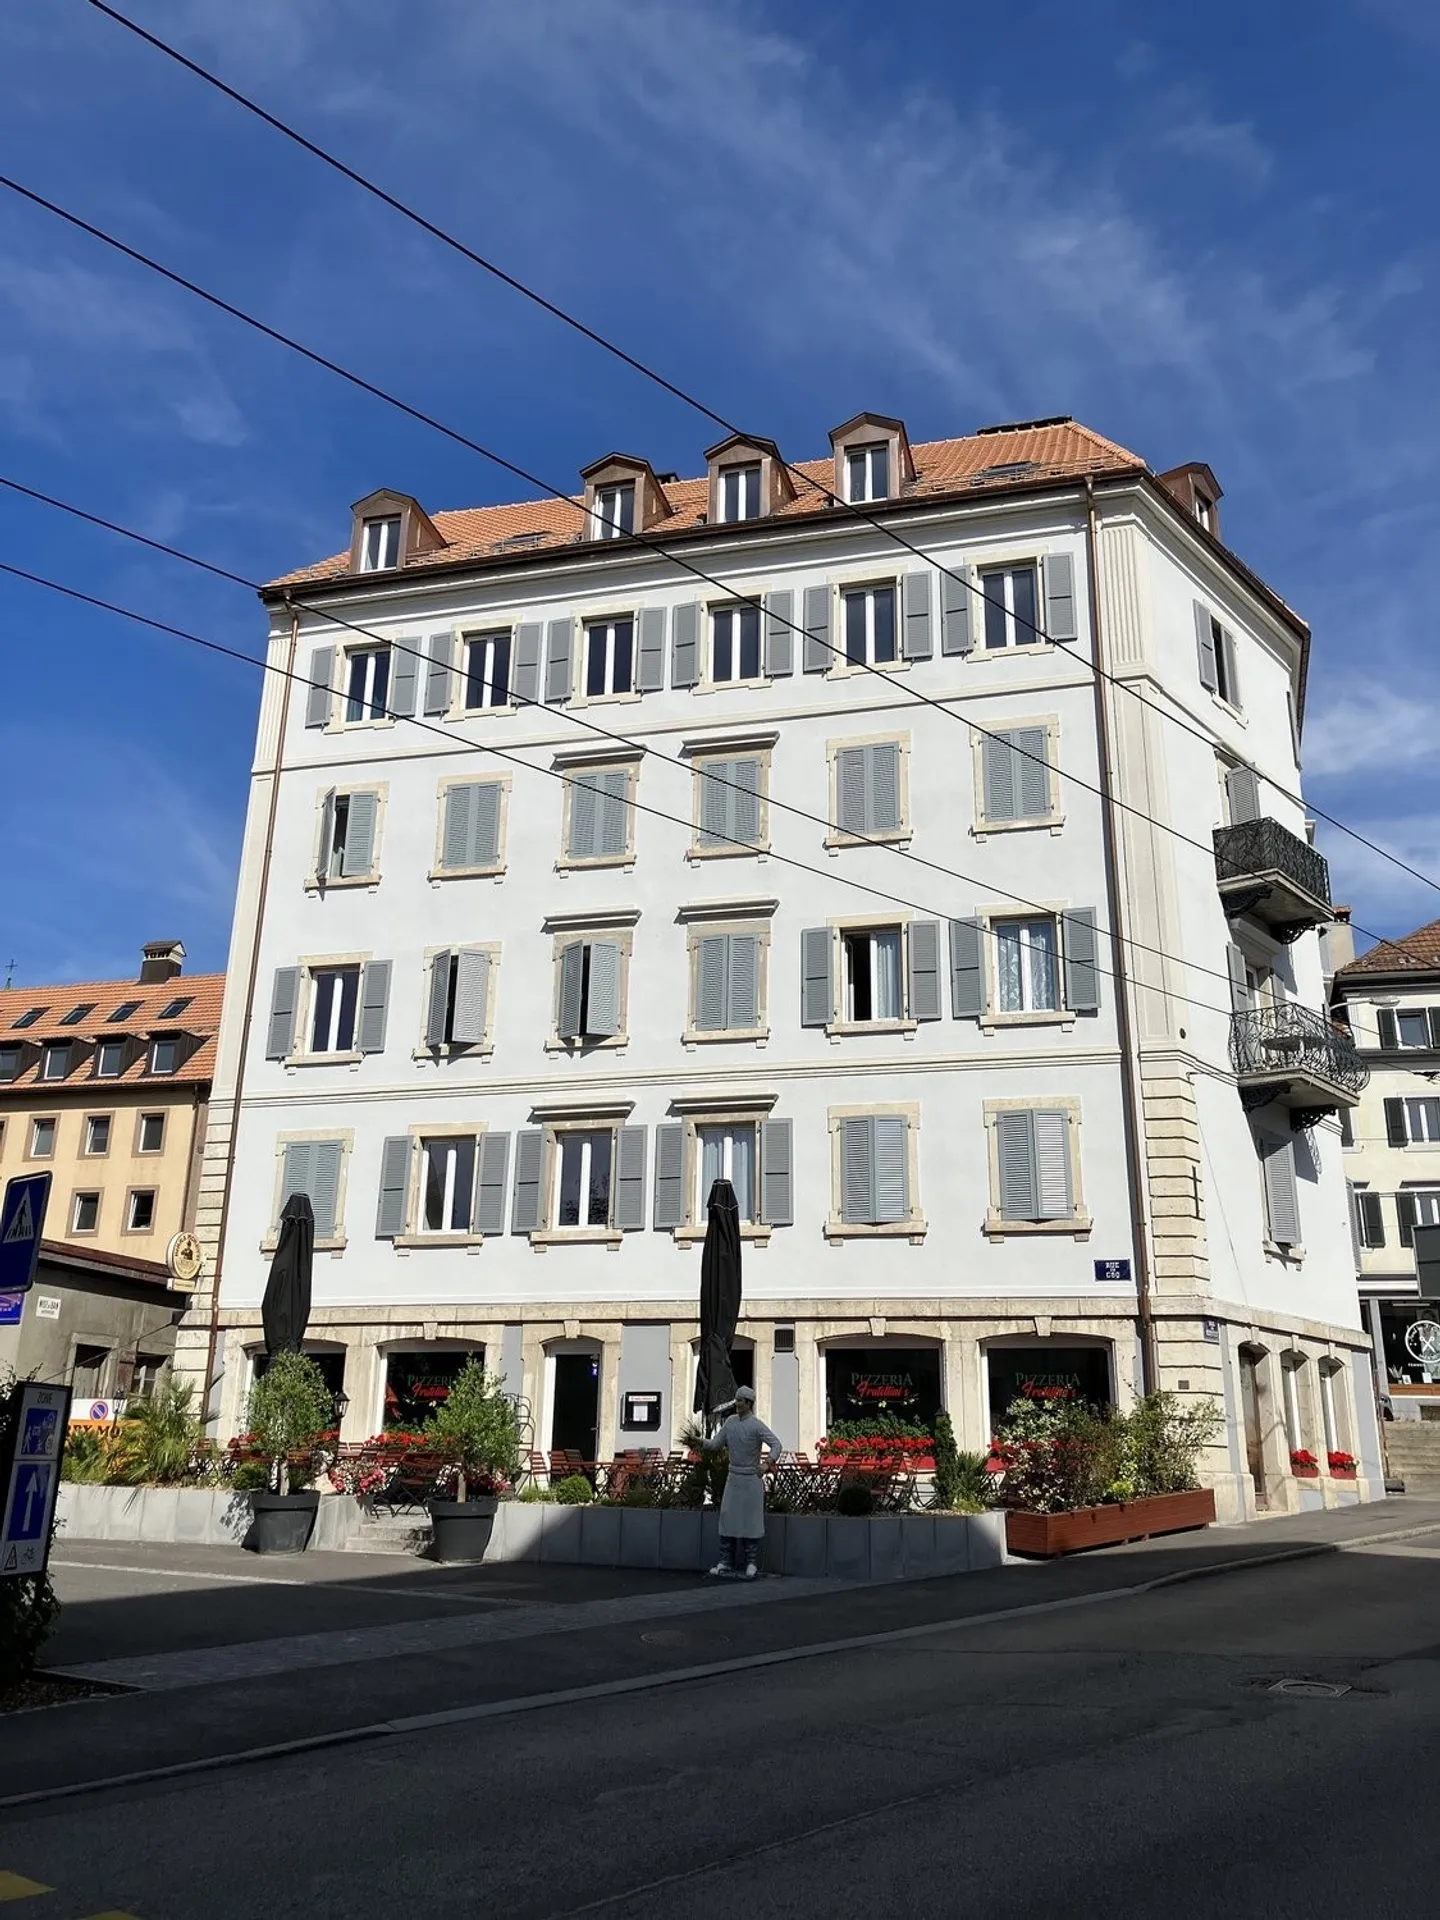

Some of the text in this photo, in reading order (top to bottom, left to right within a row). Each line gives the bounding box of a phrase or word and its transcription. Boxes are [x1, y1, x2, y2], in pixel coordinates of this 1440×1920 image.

[407, 1374, 453, 1387] PIZZERI
[851, 1372, 913, 1386] PIZZERIA
[1015, 1372, 1081, 1386] PIZZERIA
[37, 1391, 52, 1405] ZONE
